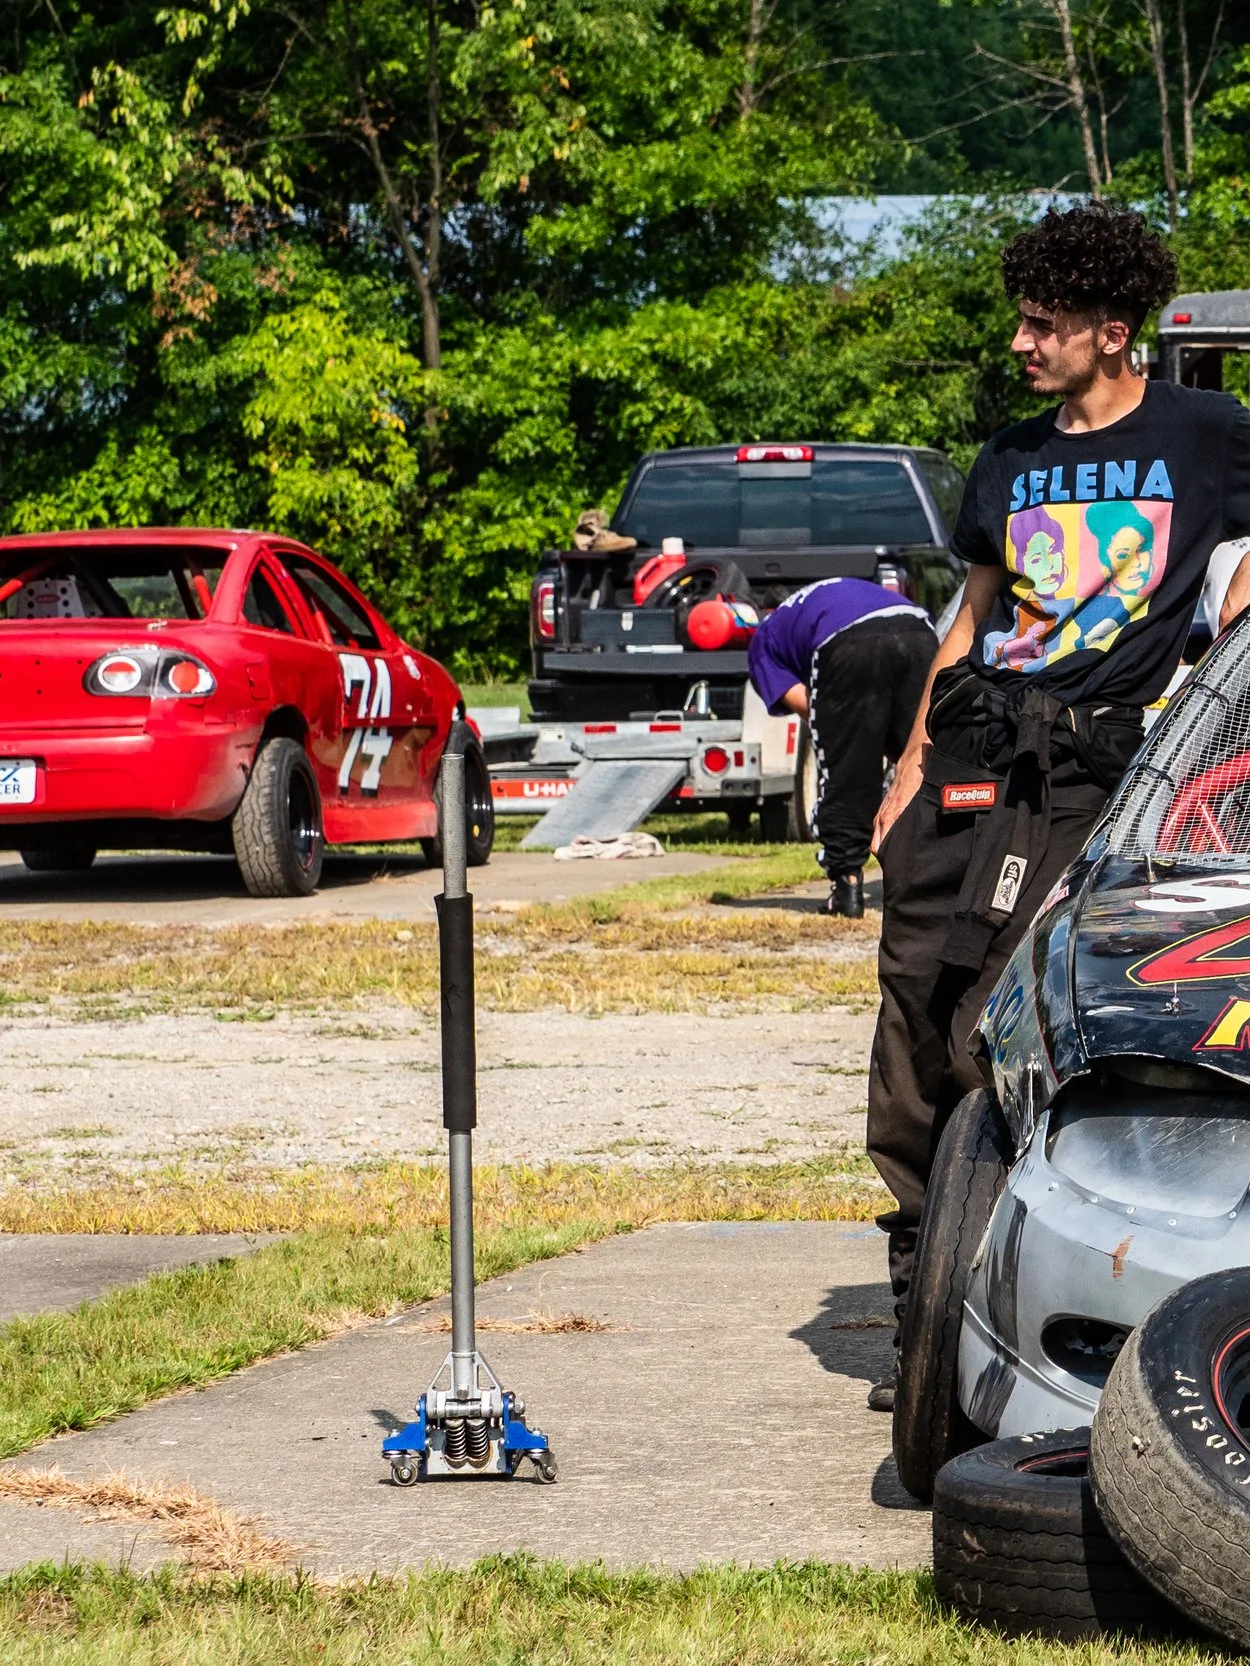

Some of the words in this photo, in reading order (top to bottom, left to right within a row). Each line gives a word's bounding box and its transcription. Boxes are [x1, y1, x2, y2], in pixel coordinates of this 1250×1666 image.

[1009, 459, 1175, 512] SELENA
[338, 653, 394, 793] 74
[0, 784, 21, 795] ER
[523, 782, 577, 797] U-HA
[949, 789, 991, 801] RaceQuip
